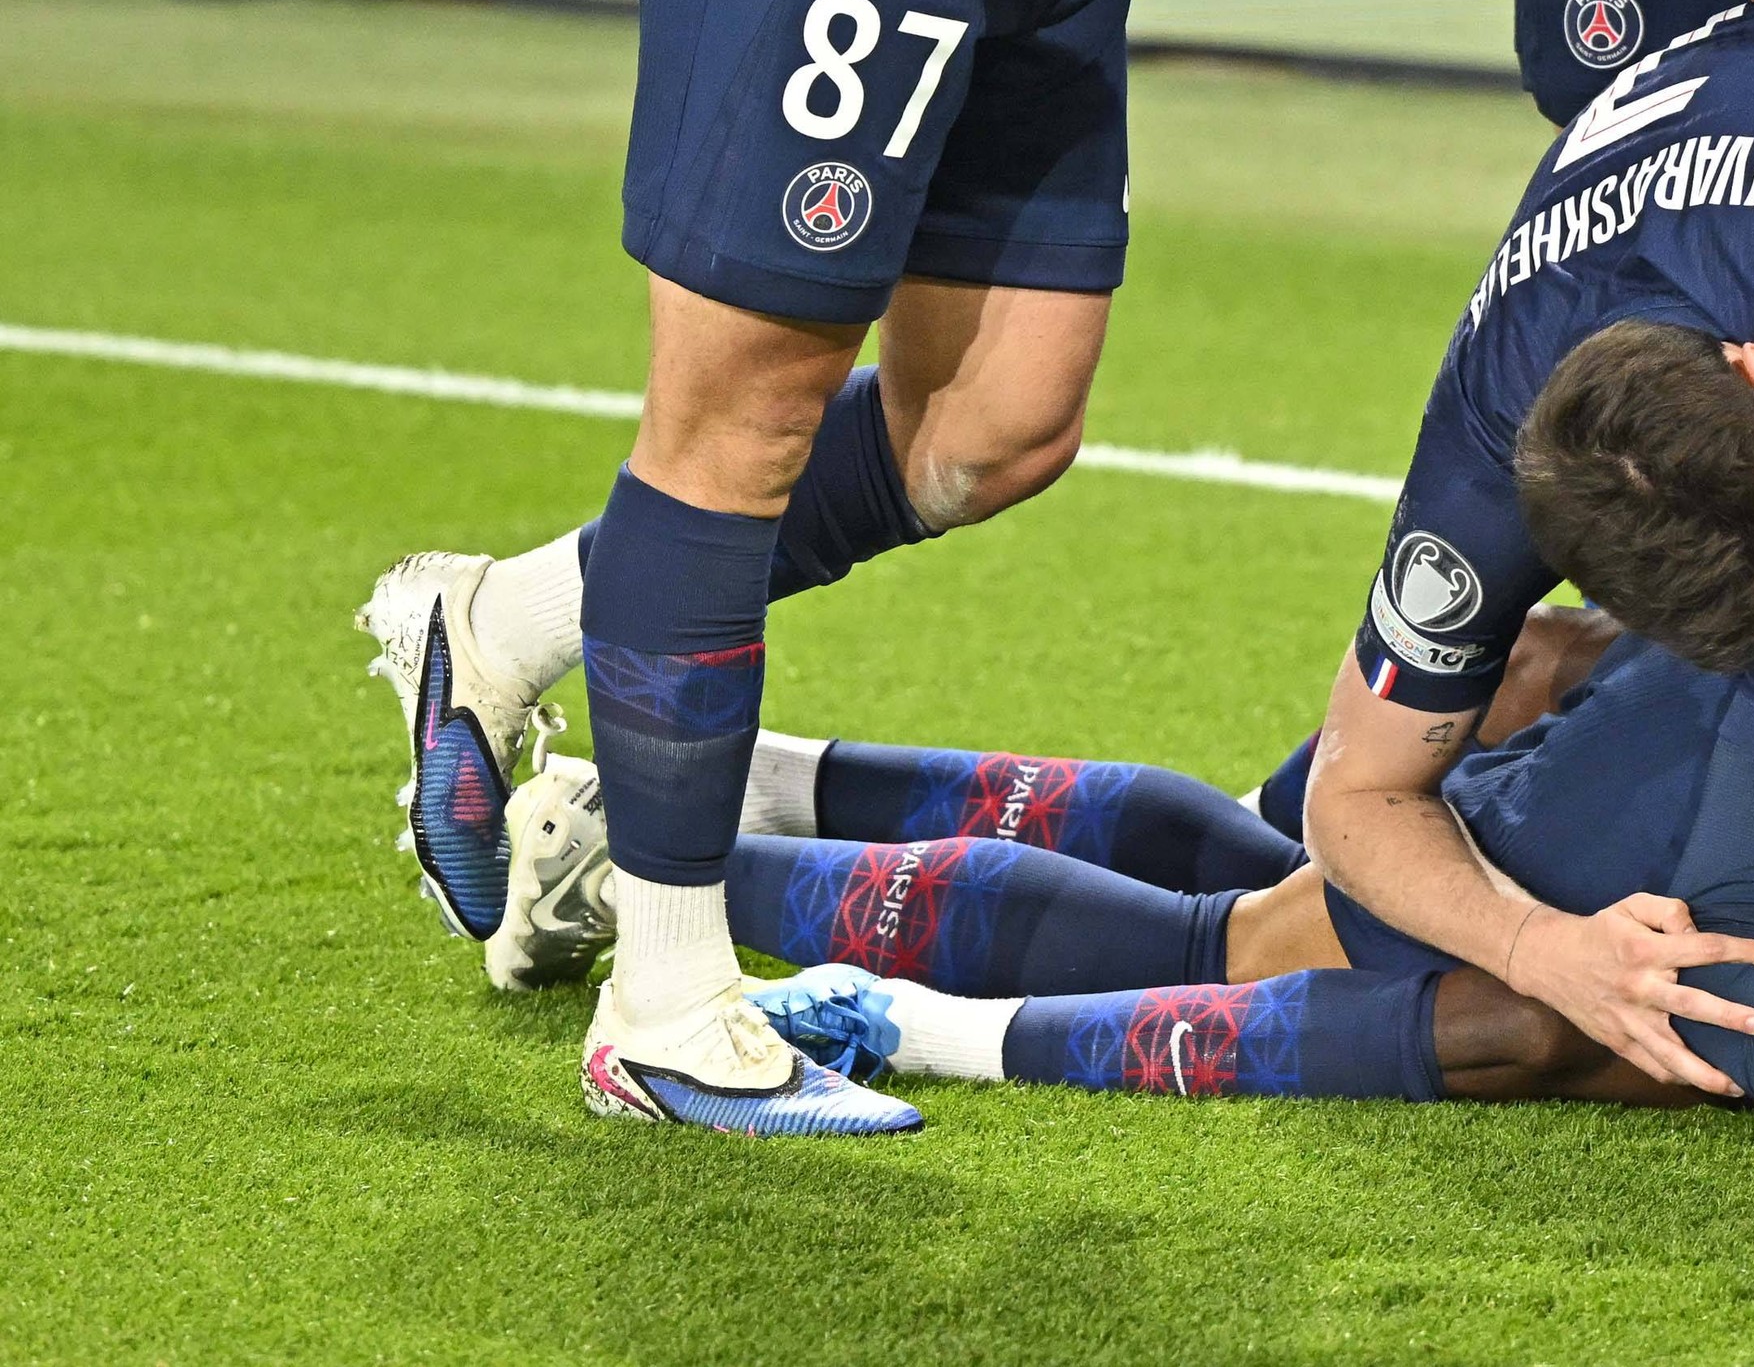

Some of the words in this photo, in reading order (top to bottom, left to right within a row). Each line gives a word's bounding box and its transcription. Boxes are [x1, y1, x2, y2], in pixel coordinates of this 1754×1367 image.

[807, 166, 864, 194] PARIS
[814, 230, 850, 244] GERMAIN
[996, 764, 1041, 840] PARI
